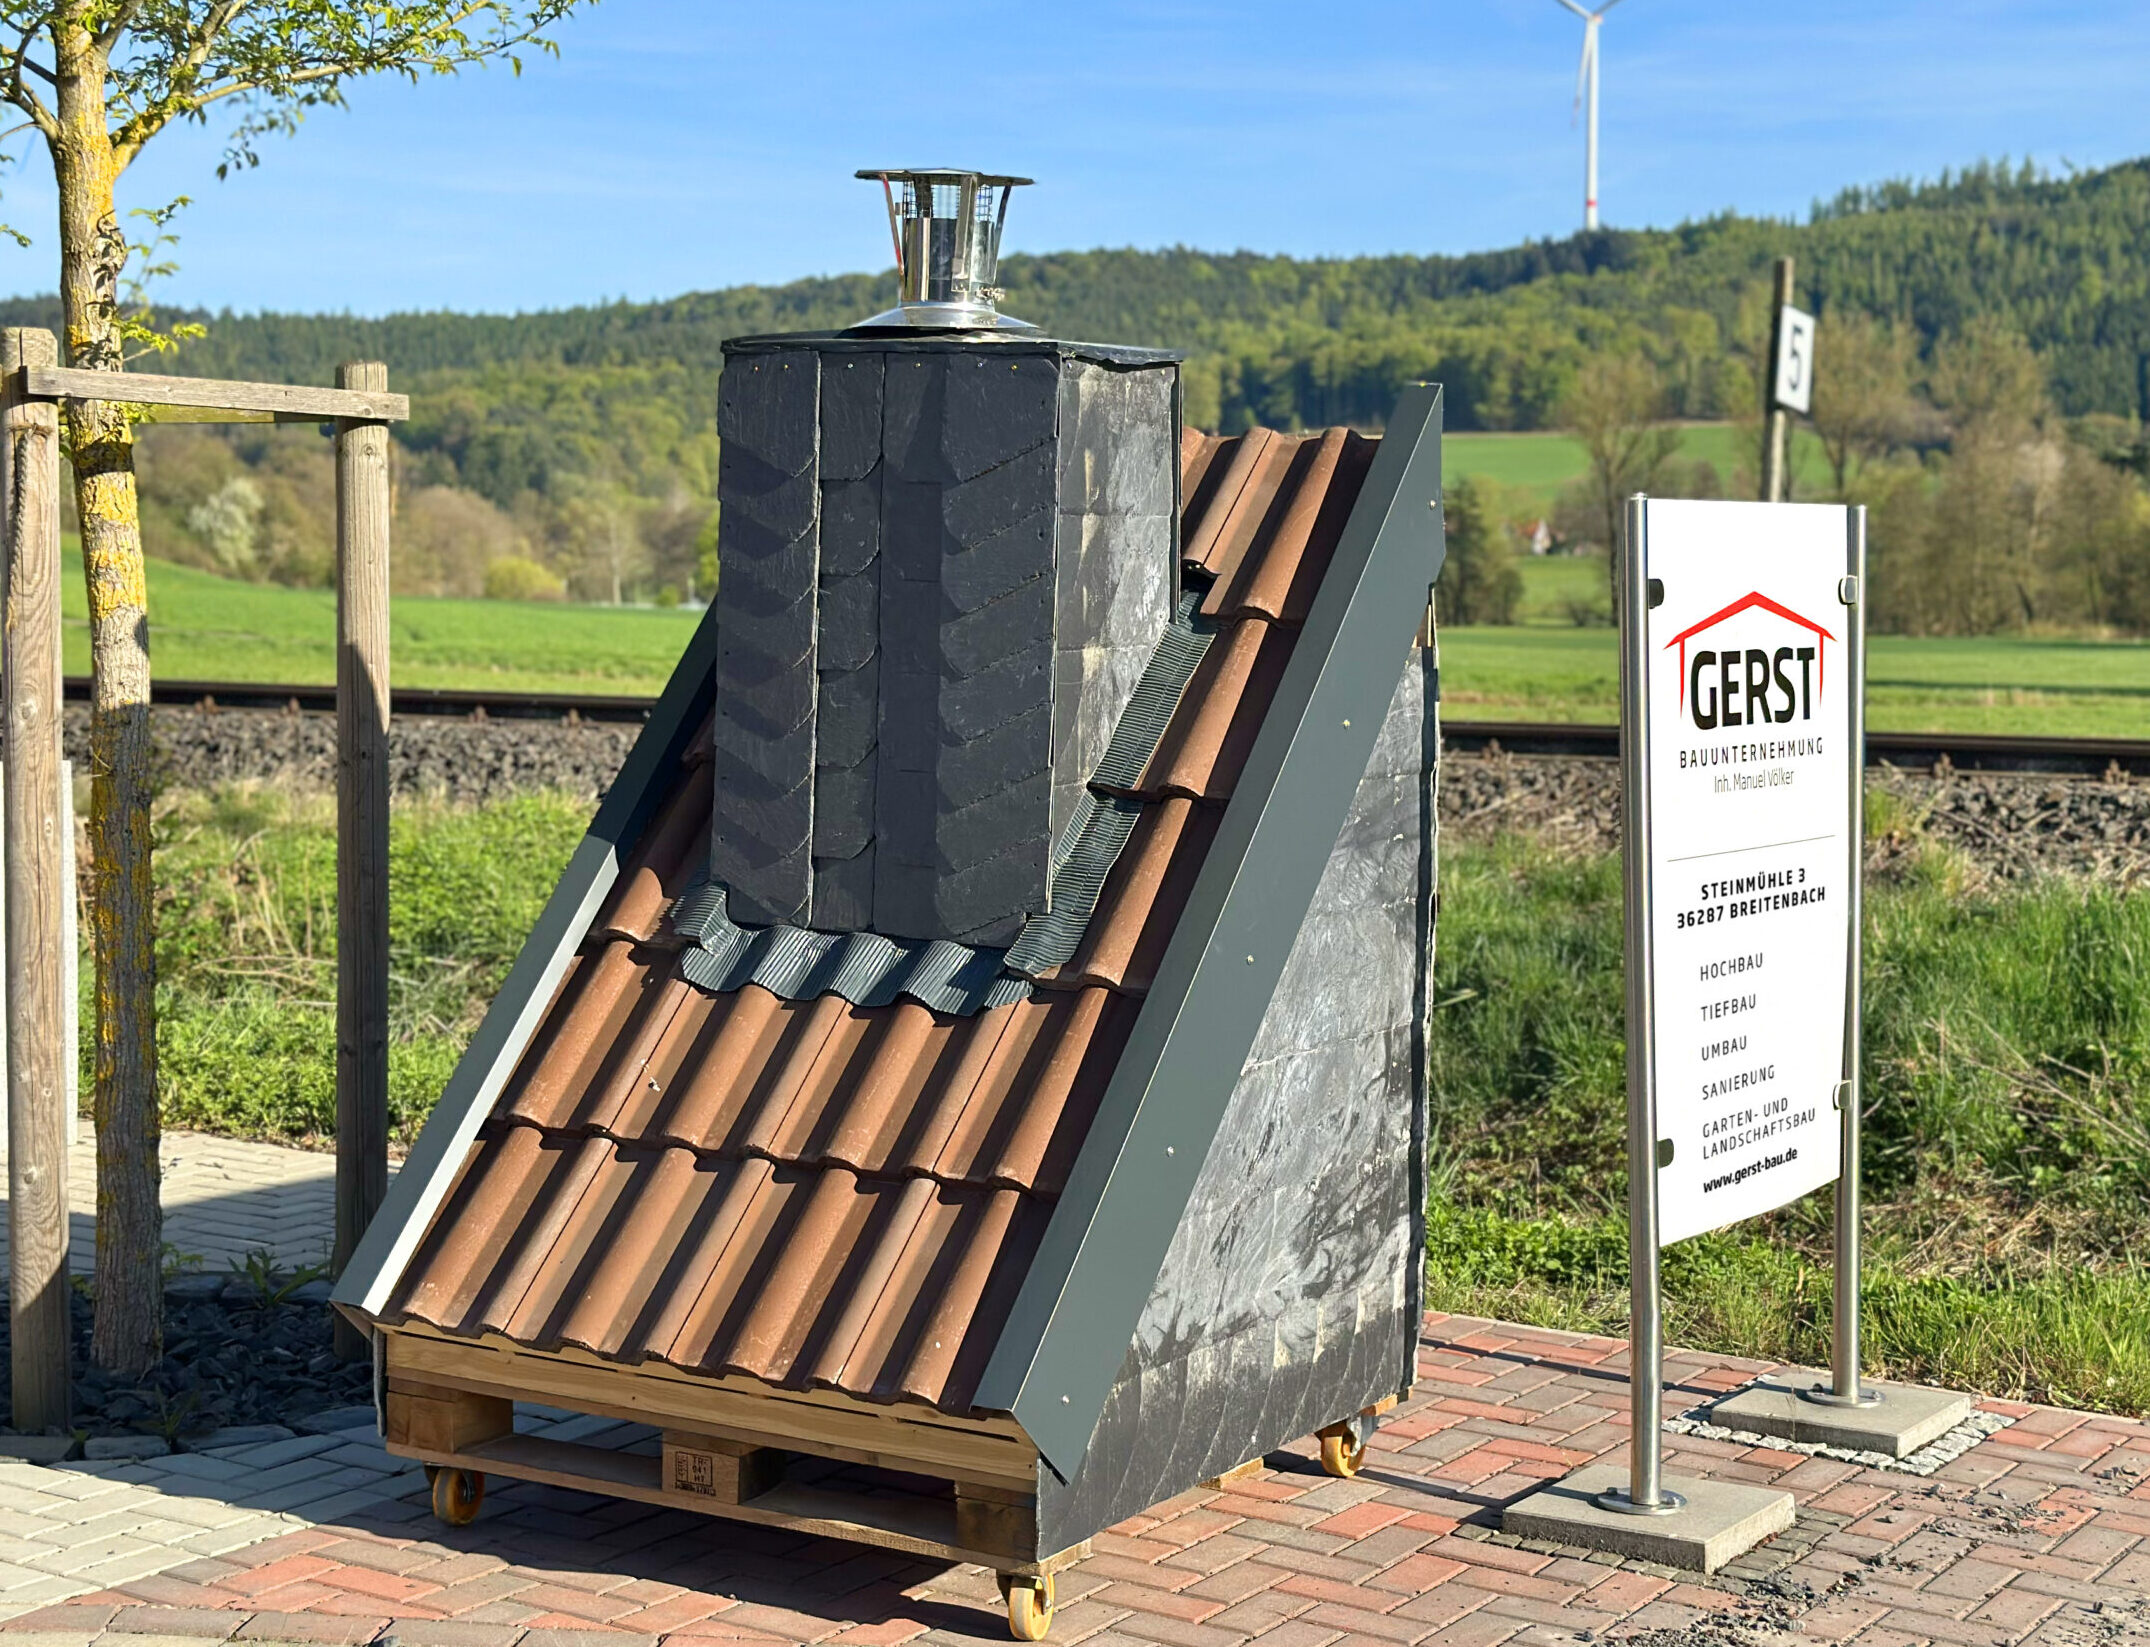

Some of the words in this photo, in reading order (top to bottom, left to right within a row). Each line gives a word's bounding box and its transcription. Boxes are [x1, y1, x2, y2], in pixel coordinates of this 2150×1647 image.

[1789, 324, 1803, 392] 5
[1690, 646, 1815, 730] GERST
[1679, 736, 1823, 769] BAUUNTERNEHMUNG
[1714, 775, 1732, 794] Inh.
[1733, 770, 1766, 791] Manuel
[1767, 767, 1795, 787] Völker
[1700, 869, 1793, 901] STEINMÜHLE
[1798, 867, 1806, 884] 3
[1676, 904, 1724, 929] 36287
[1729, 885, 1826, 919] BREITENBACH
[1700, 952, 1763, 982] HOCHBAU
[1700, 993, 1756, 1022] TIEFBAU
[1701, 1035, 1747, 1062] UMBAU
[1702, 1064, 1775, 1100] SANIERUNG
[1702, 1108, 1759, 1139] GARTEN-
[1763, 1097, 1788, 1118] UND
[1703, 1107, 1816, 1160] LANDSCHAFTSBAU
[1703, 1147, 1798, 1194] www.gerst-bau.de
